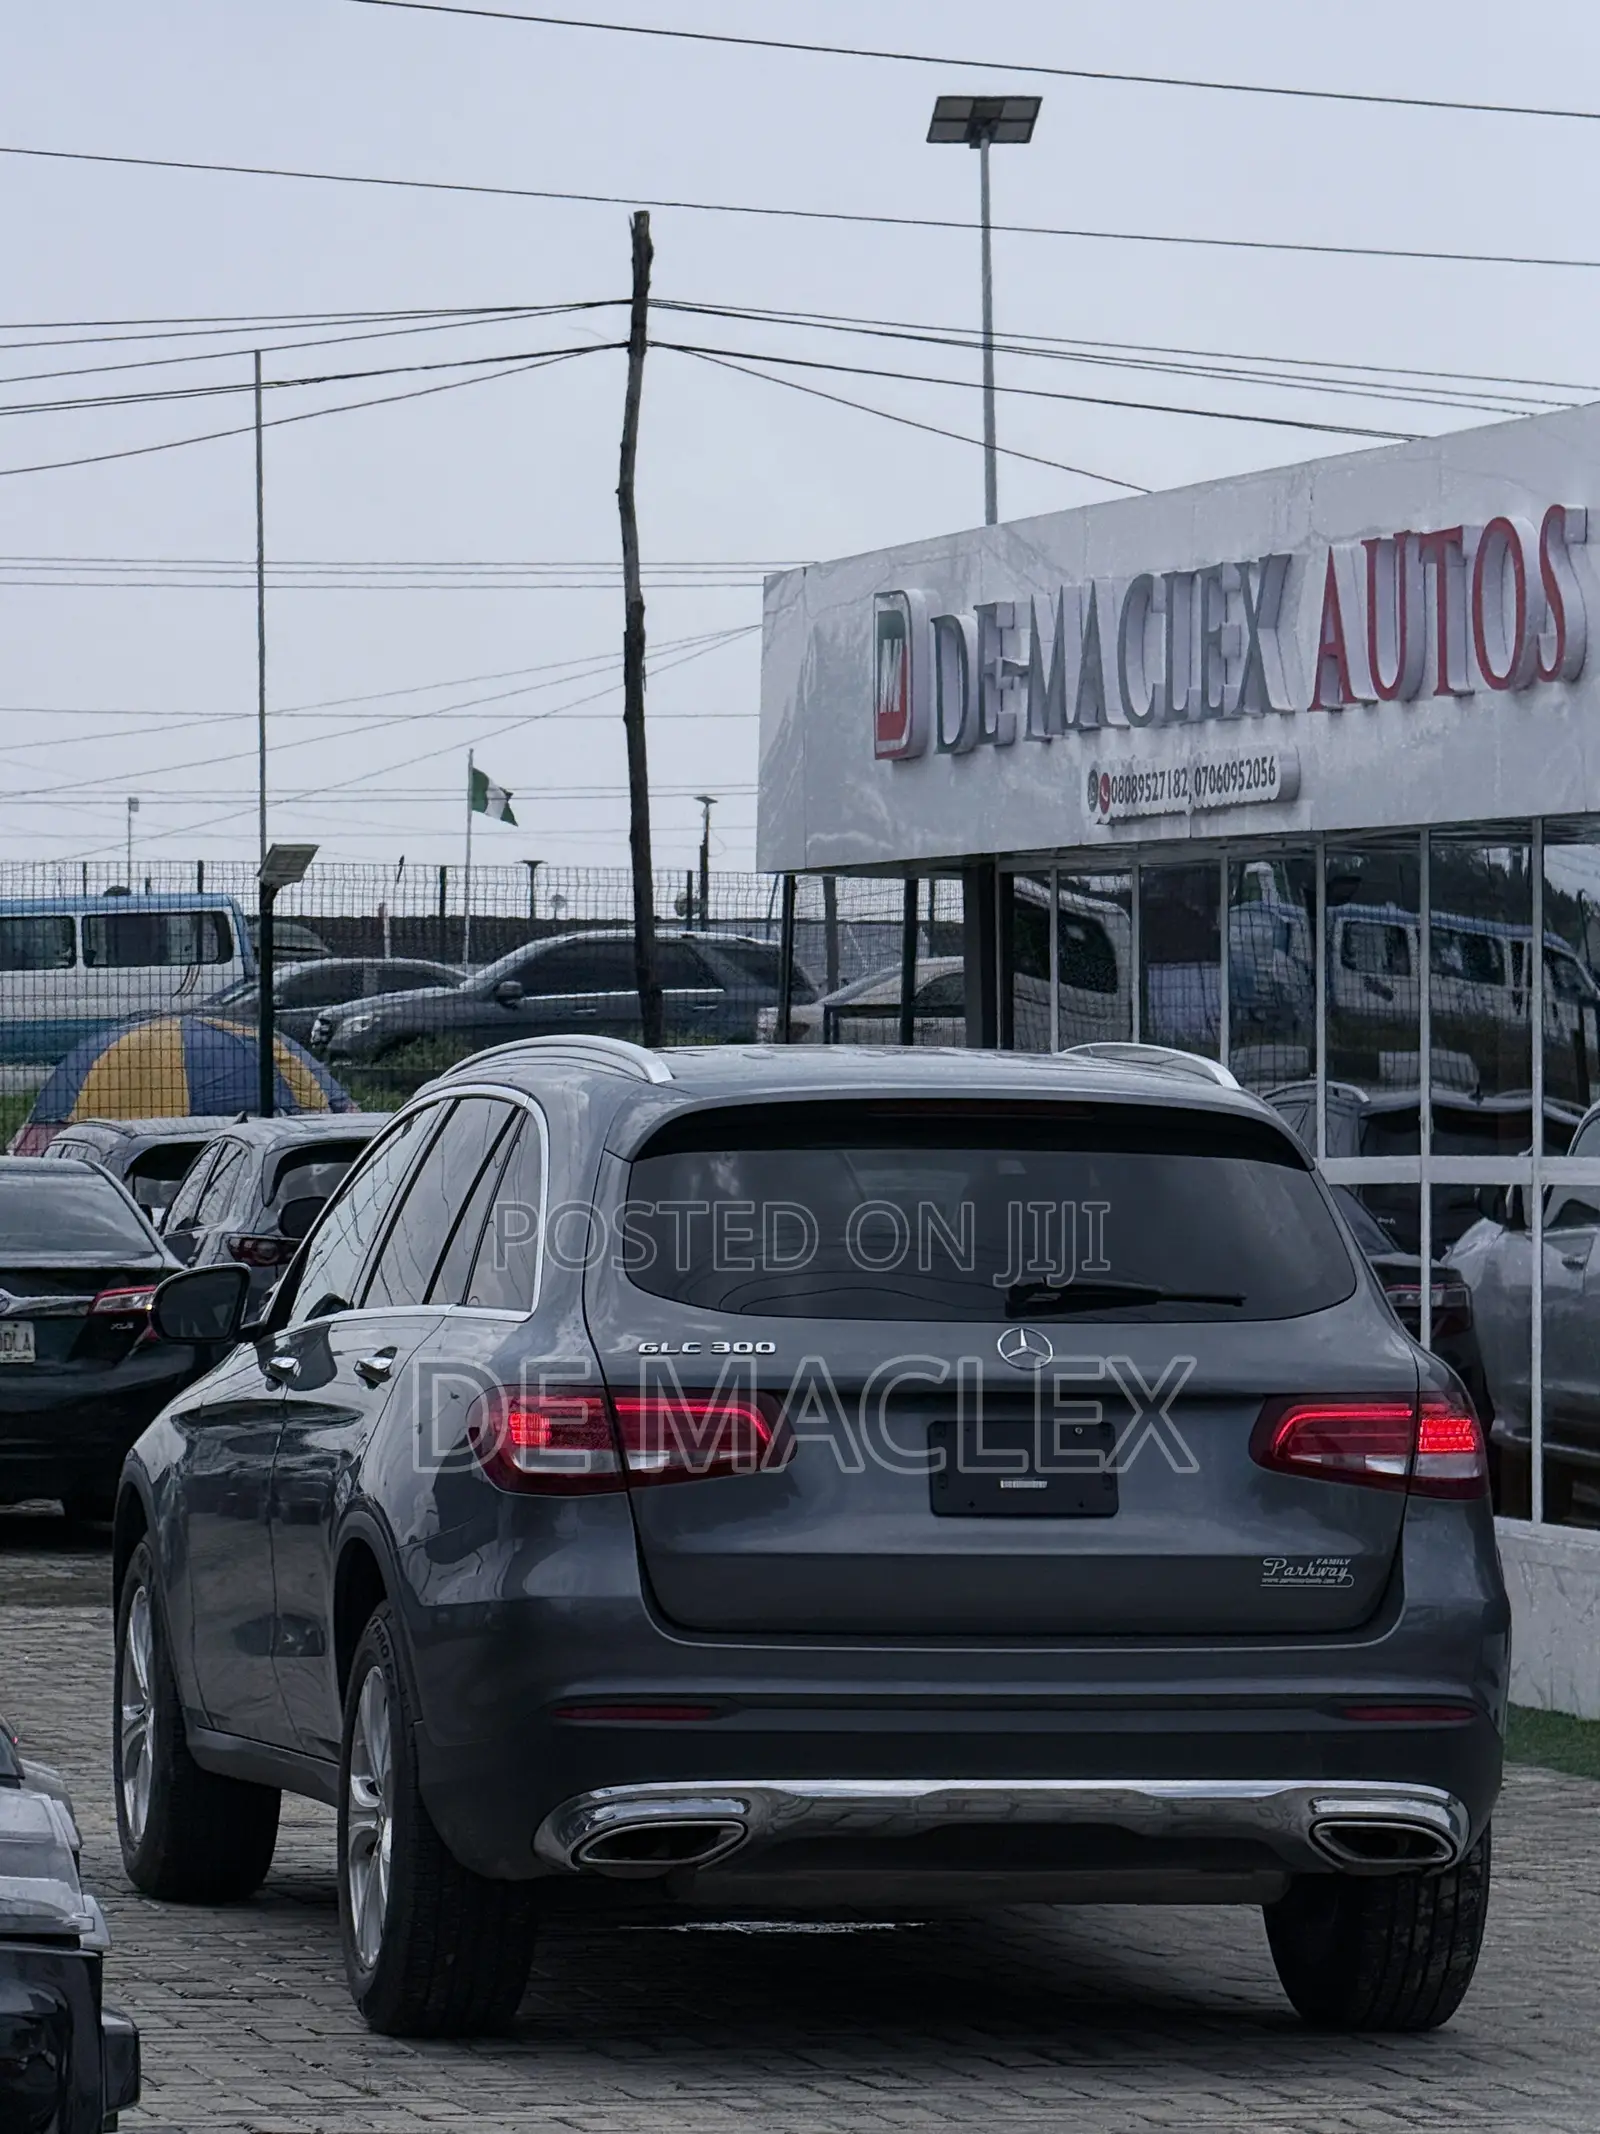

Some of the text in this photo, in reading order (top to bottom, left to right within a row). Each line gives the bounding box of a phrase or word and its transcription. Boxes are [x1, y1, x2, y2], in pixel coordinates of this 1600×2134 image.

[1306, 504, 1580, 712] AUTOS
[1194, 755, 1277, 798] 07060952056
[638, 1341, 776, 1353] GLC 300
[1262, 1557, 1350, 1584] Parkway
